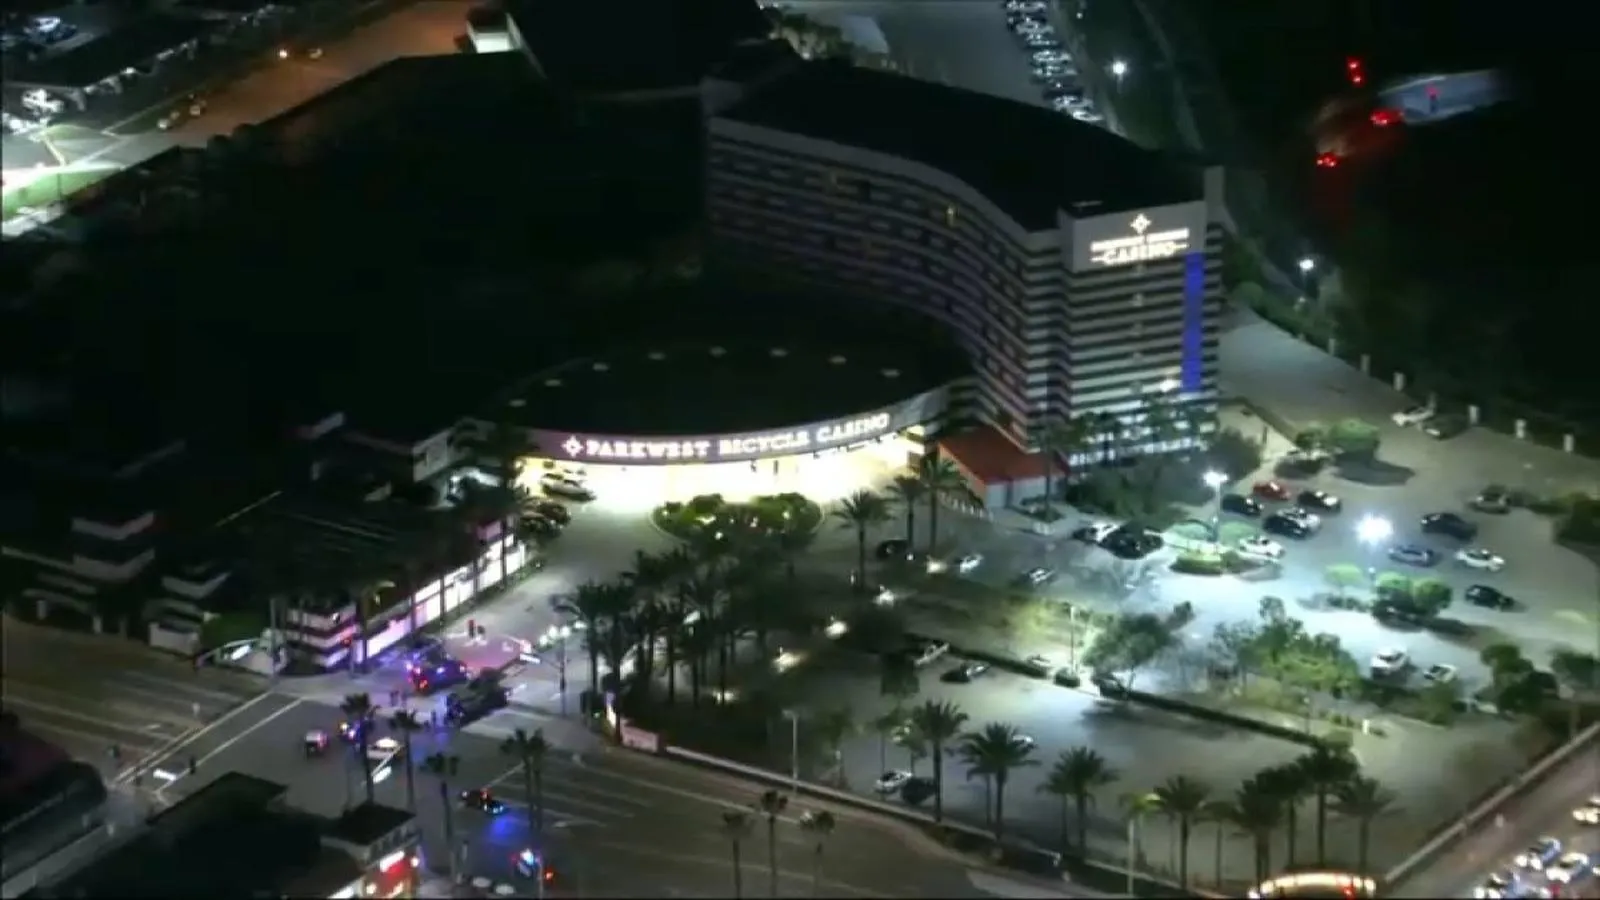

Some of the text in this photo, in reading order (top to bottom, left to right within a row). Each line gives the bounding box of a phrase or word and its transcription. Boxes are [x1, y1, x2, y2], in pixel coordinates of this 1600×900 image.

[586, 413, 890, 457] PARKWEST BICYCLE CASINO
